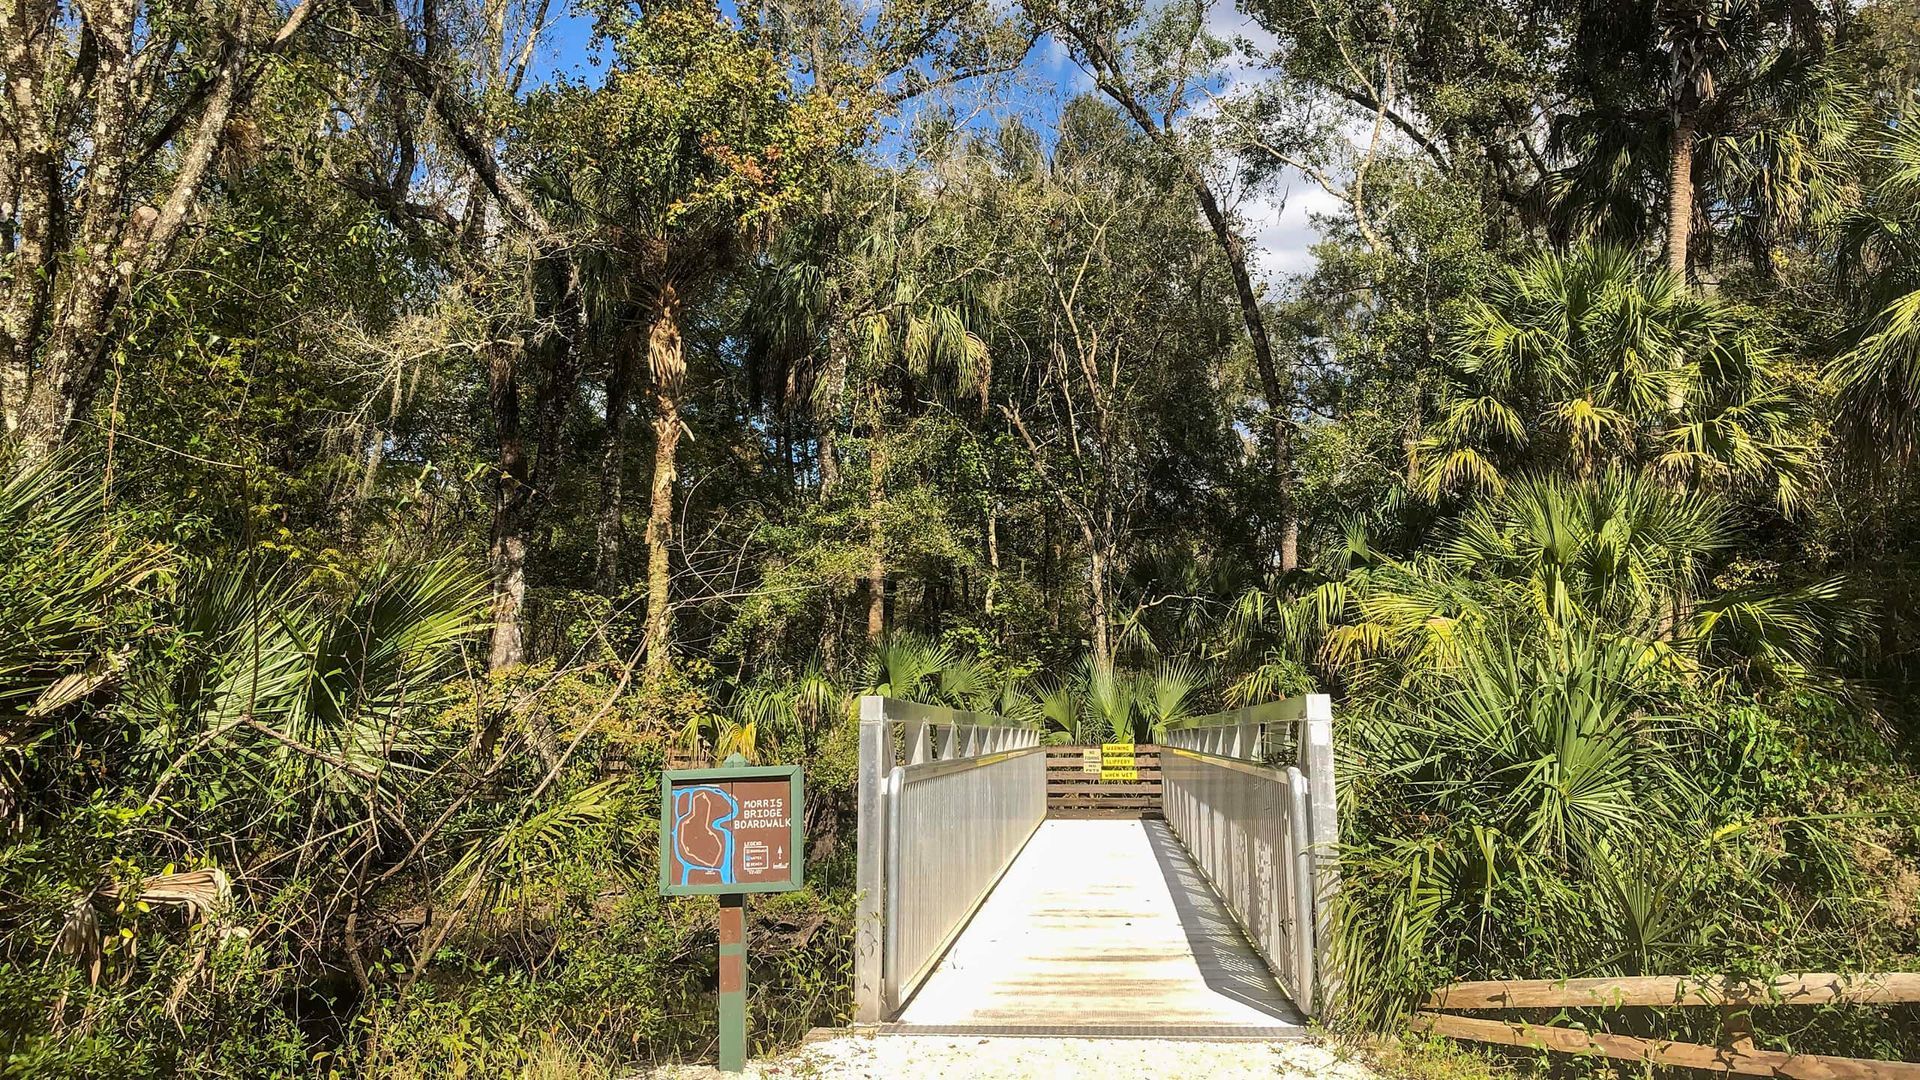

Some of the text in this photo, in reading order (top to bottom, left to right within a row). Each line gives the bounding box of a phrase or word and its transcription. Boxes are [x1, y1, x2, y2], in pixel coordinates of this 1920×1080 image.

[743, 798, 783, 809] MORRIS
[743, 808, 783, 819] BRIDGE
[734, 818, 792, 830] BOARDWALK
